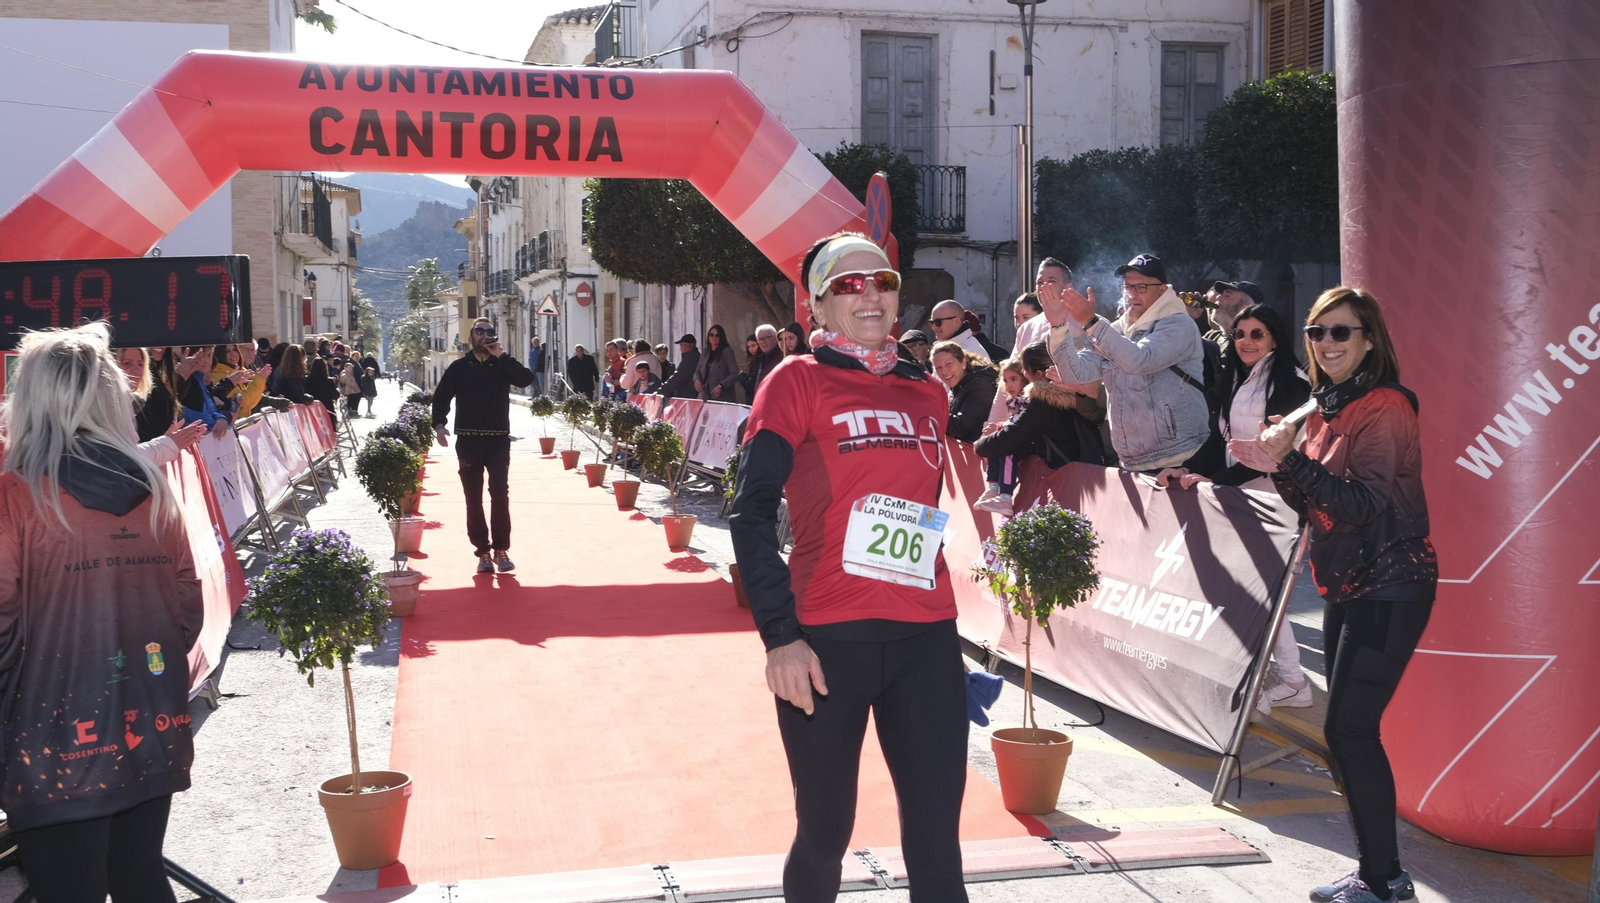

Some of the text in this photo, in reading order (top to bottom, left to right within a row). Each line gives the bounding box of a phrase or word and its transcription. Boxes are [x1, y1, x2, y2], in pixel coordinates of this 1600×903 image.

[298, 64, 634, 100] AYUNTAMIENTO
[308, 106, 623, 162] CANTORIA
[831, 410, 915, 437] TRI
[863, 505, 875, 515] LA
[878, 508, 917, 525] PÓLVORA
[870, 494, 882, 504] IV
[883, 497, 907, 510] CxM
[866, 523, 924, 564] 206
[65, 555, 172, 573] VALLE DE ALMANZO
[1092, 576, 1225, 641] TEAMERGY
[61, 744, 118, 761] COSENTINO
